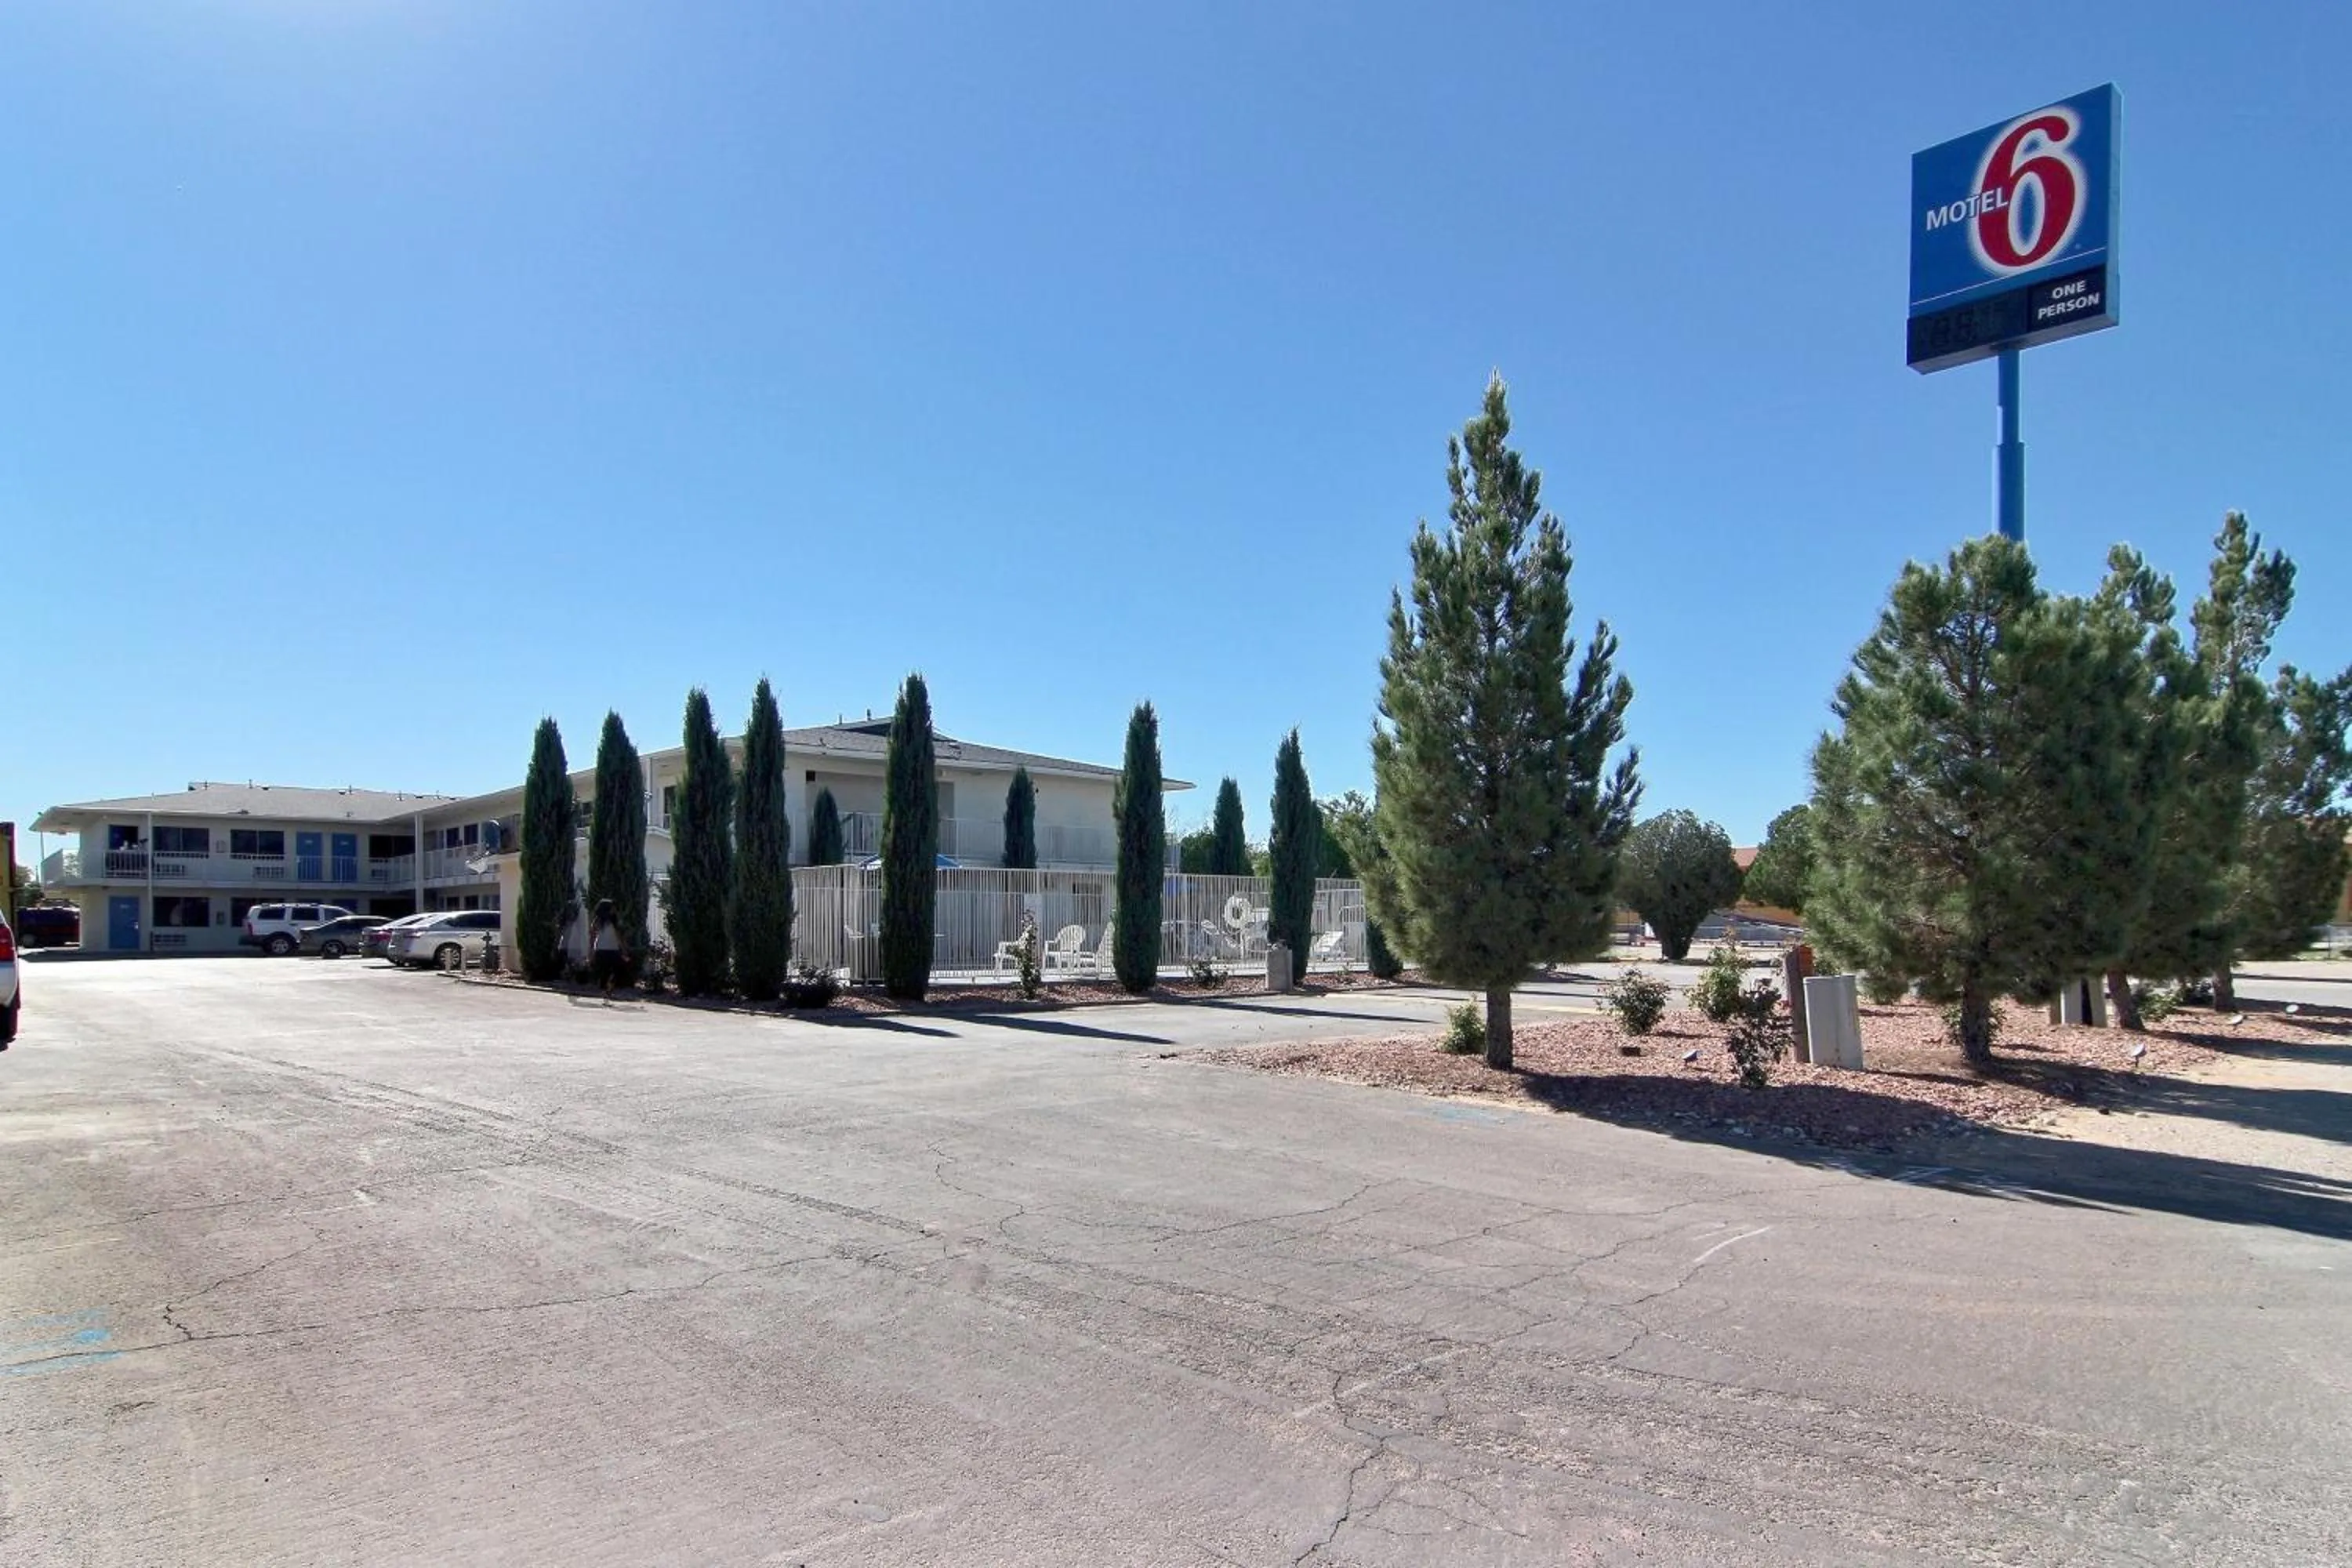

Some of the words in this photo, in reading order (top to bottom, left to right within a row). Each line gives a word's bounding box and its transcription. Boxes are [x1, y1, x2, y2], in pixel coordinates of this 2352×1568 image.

[1926, 187, 2009, 230] MOTEL
[1978, 115, 2076, 267] 6
[2052, 280, 2086, 299] ONE
[2038, 293, 2100, 320] PERSON
